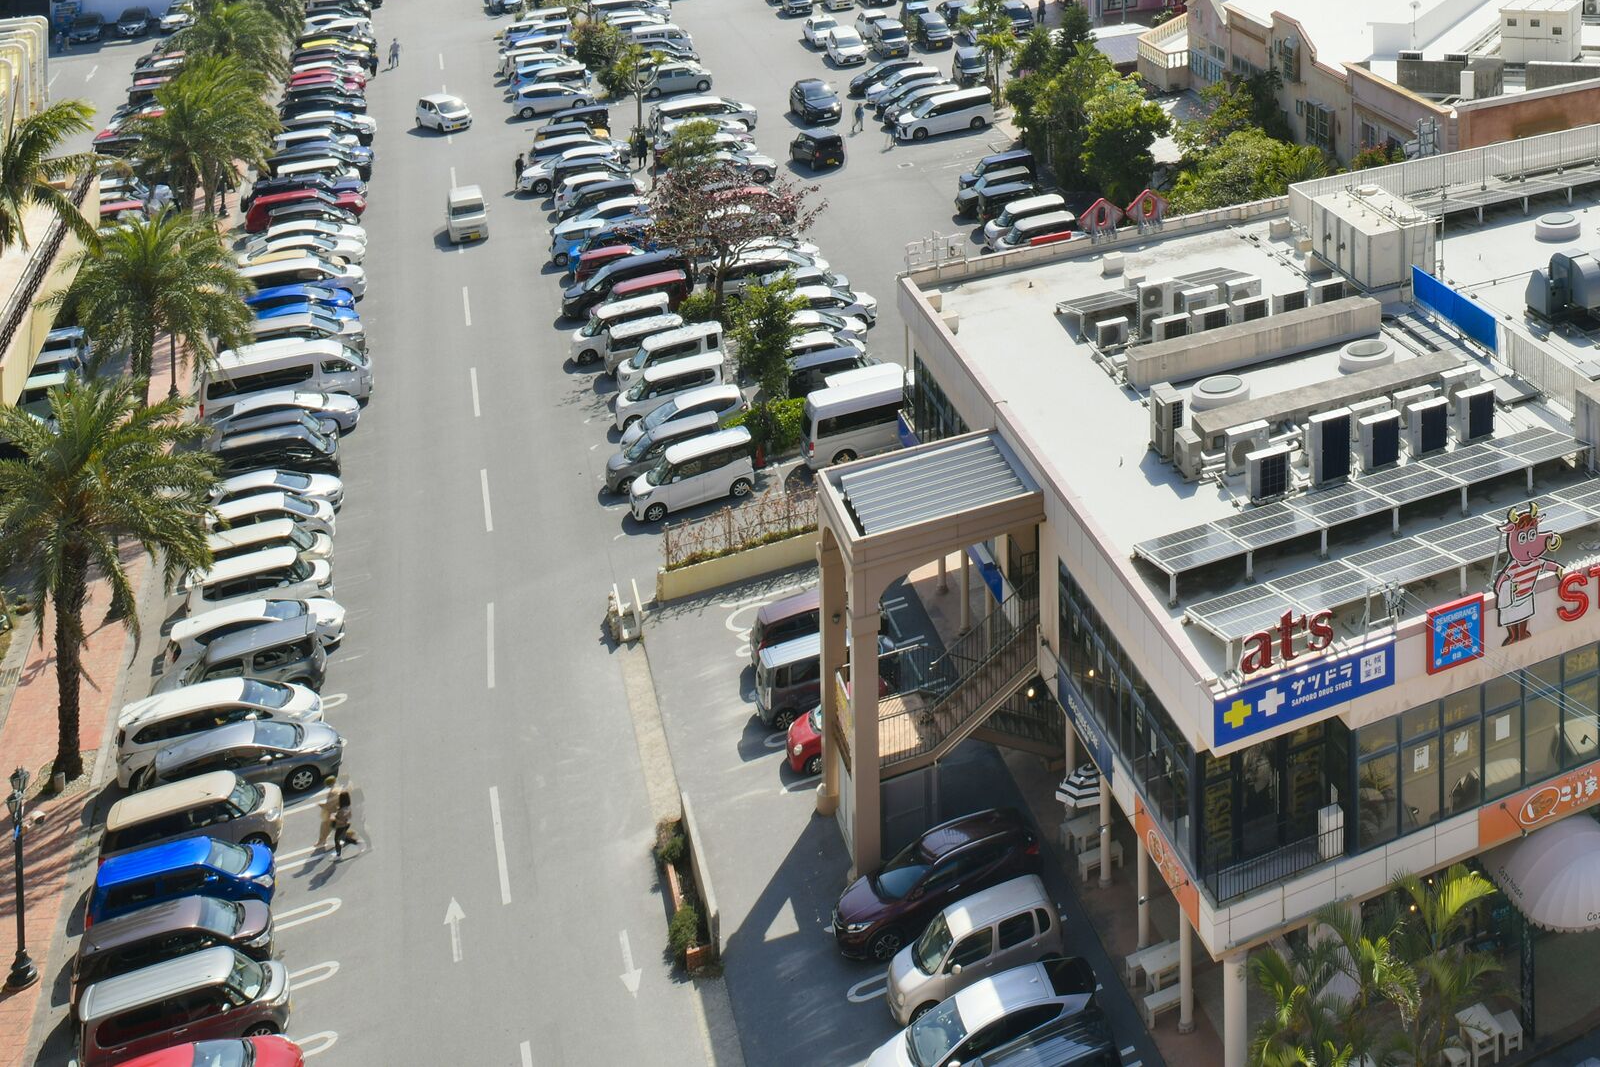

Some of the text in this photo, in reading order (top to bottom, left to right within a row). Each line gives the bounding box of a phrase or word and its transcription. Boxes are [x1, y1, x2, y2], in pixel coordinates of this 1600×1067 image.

[1435, 606, 1477, 626] REMEMBRANCE
[1291, 662, 1353, 696] サツドラ
[1291, 679, 1353, 707] SAPPORO DRUG STORE
